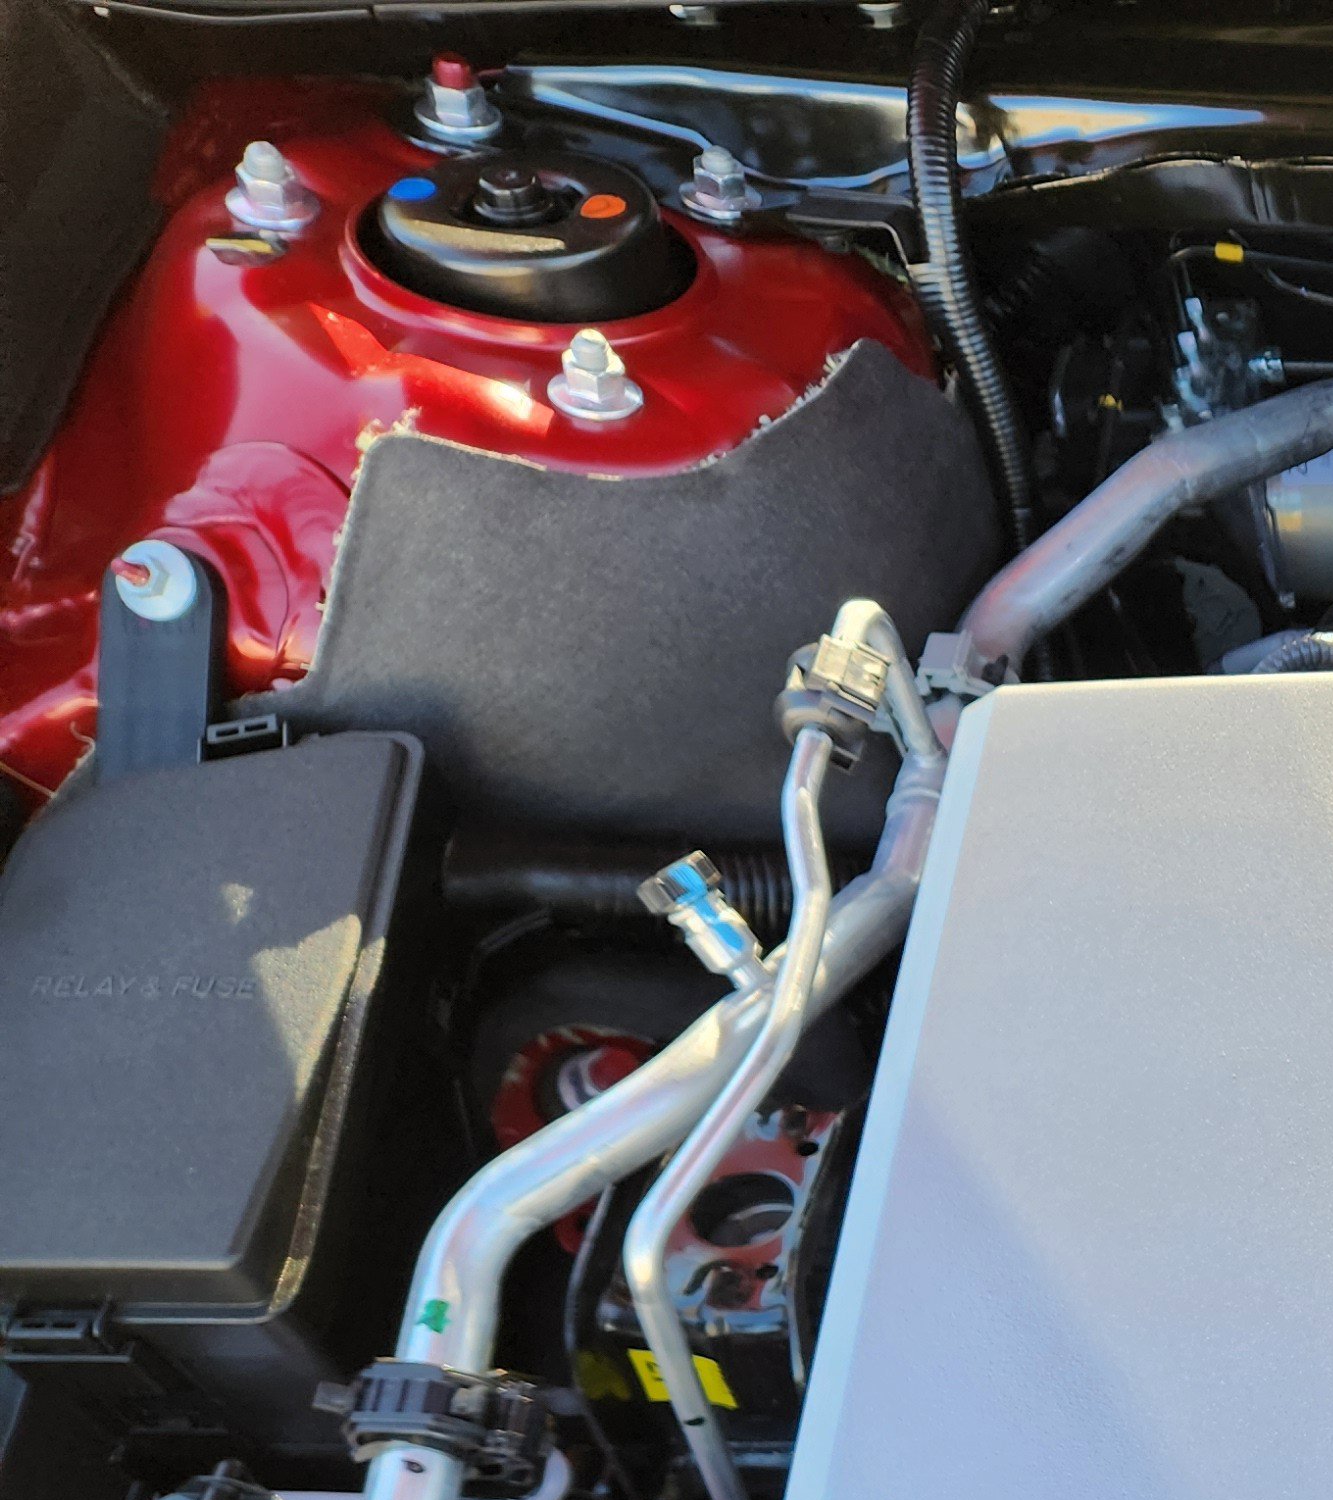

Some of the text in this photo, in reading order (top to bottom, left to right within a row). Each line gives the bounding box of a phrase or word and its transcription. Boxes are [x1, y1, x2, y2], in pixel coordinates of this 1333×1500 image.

[31, 975, 257, 998] RELAY & FUSE
